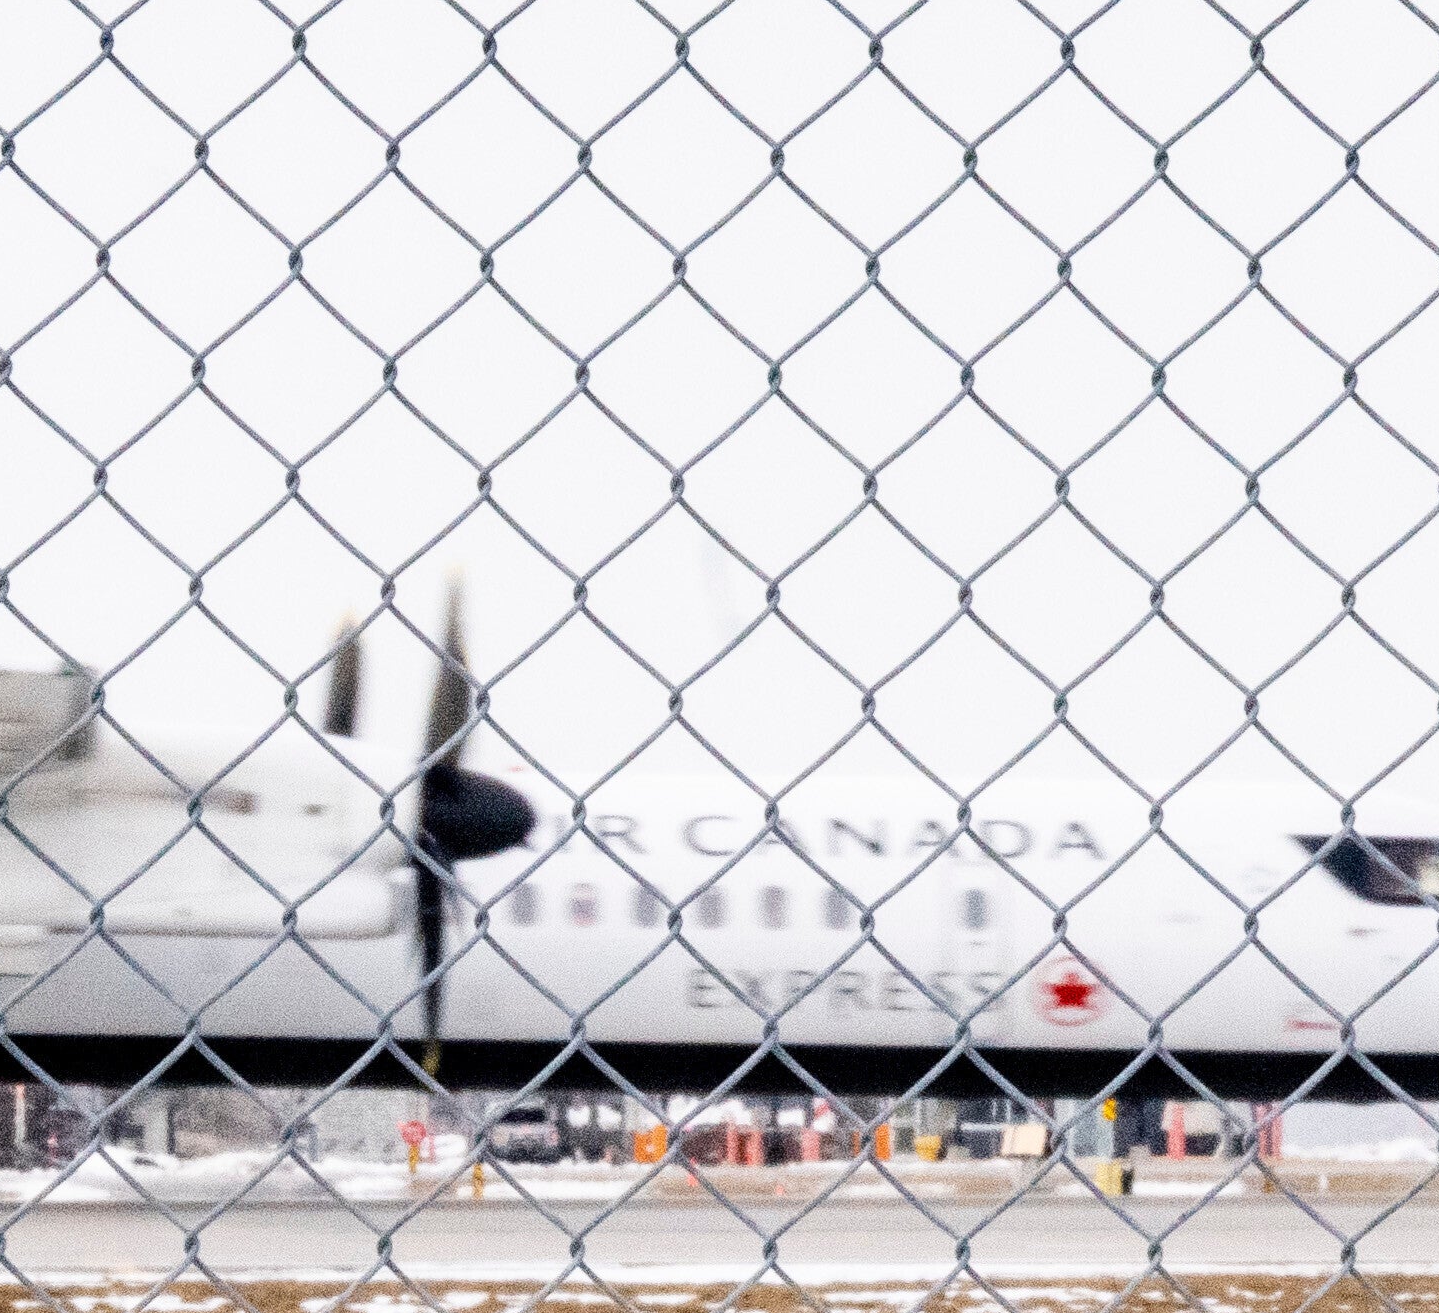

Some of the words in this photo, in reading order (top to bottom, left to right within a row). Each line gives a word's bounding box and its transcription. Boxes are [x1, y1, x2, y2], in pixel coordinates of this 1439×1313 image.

[520, 813, 648, 856] IR
[681, 814, 1109, 861] CANADA
[685, 967, 1008, 1014] EXPRESS
